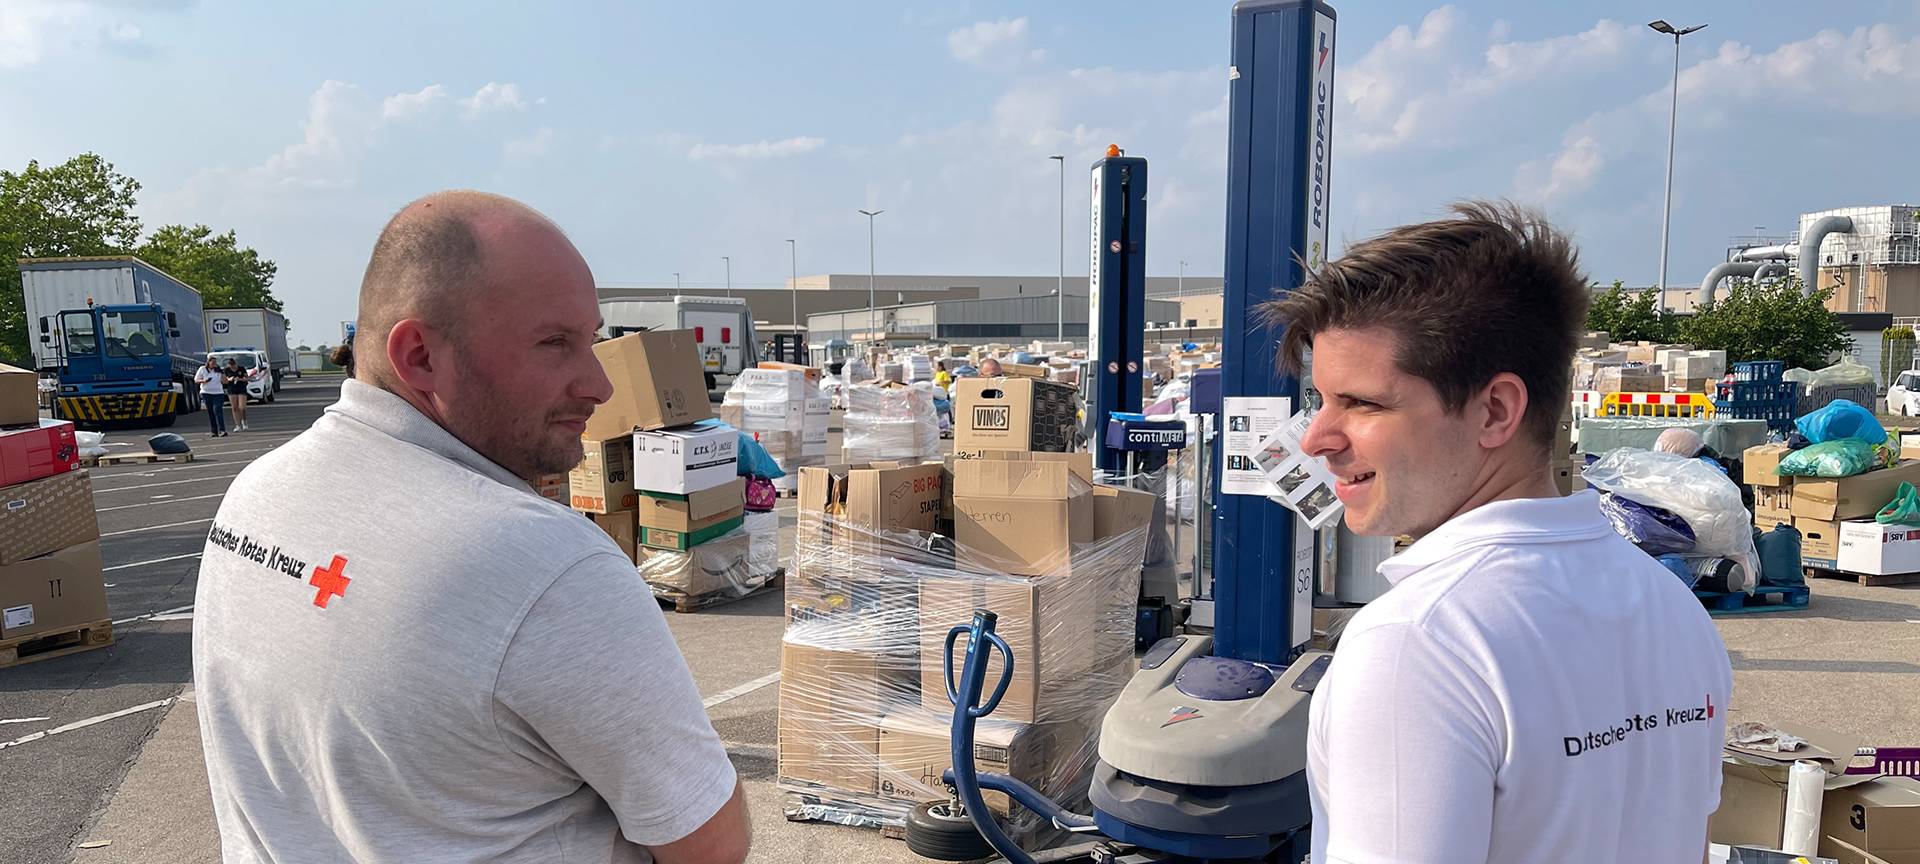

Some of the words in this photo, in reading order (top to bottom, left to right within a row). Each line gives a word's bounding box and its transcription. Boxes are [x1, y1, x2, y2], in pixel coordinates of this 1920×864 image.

[1313, 80, 1327, 230] ROBOPAC
[976, 408, 1006, 427] VINOS
[913, 478, 926, 493] BIG
[927, 474, 942, 491] PAC
[572, 494, 604, 510] OBI
[920, 498, 942, 514] STAPE
[964, 505, 1013, 525] Herren
[237, 534, 268, 565] Rotes
[266, 544, 307, 580] Kreuz
[1297, 567, 1311, 594] S6
[1666, 707, 1706, 727] Kreuz
[1849, 803, 1866, 833] 3
